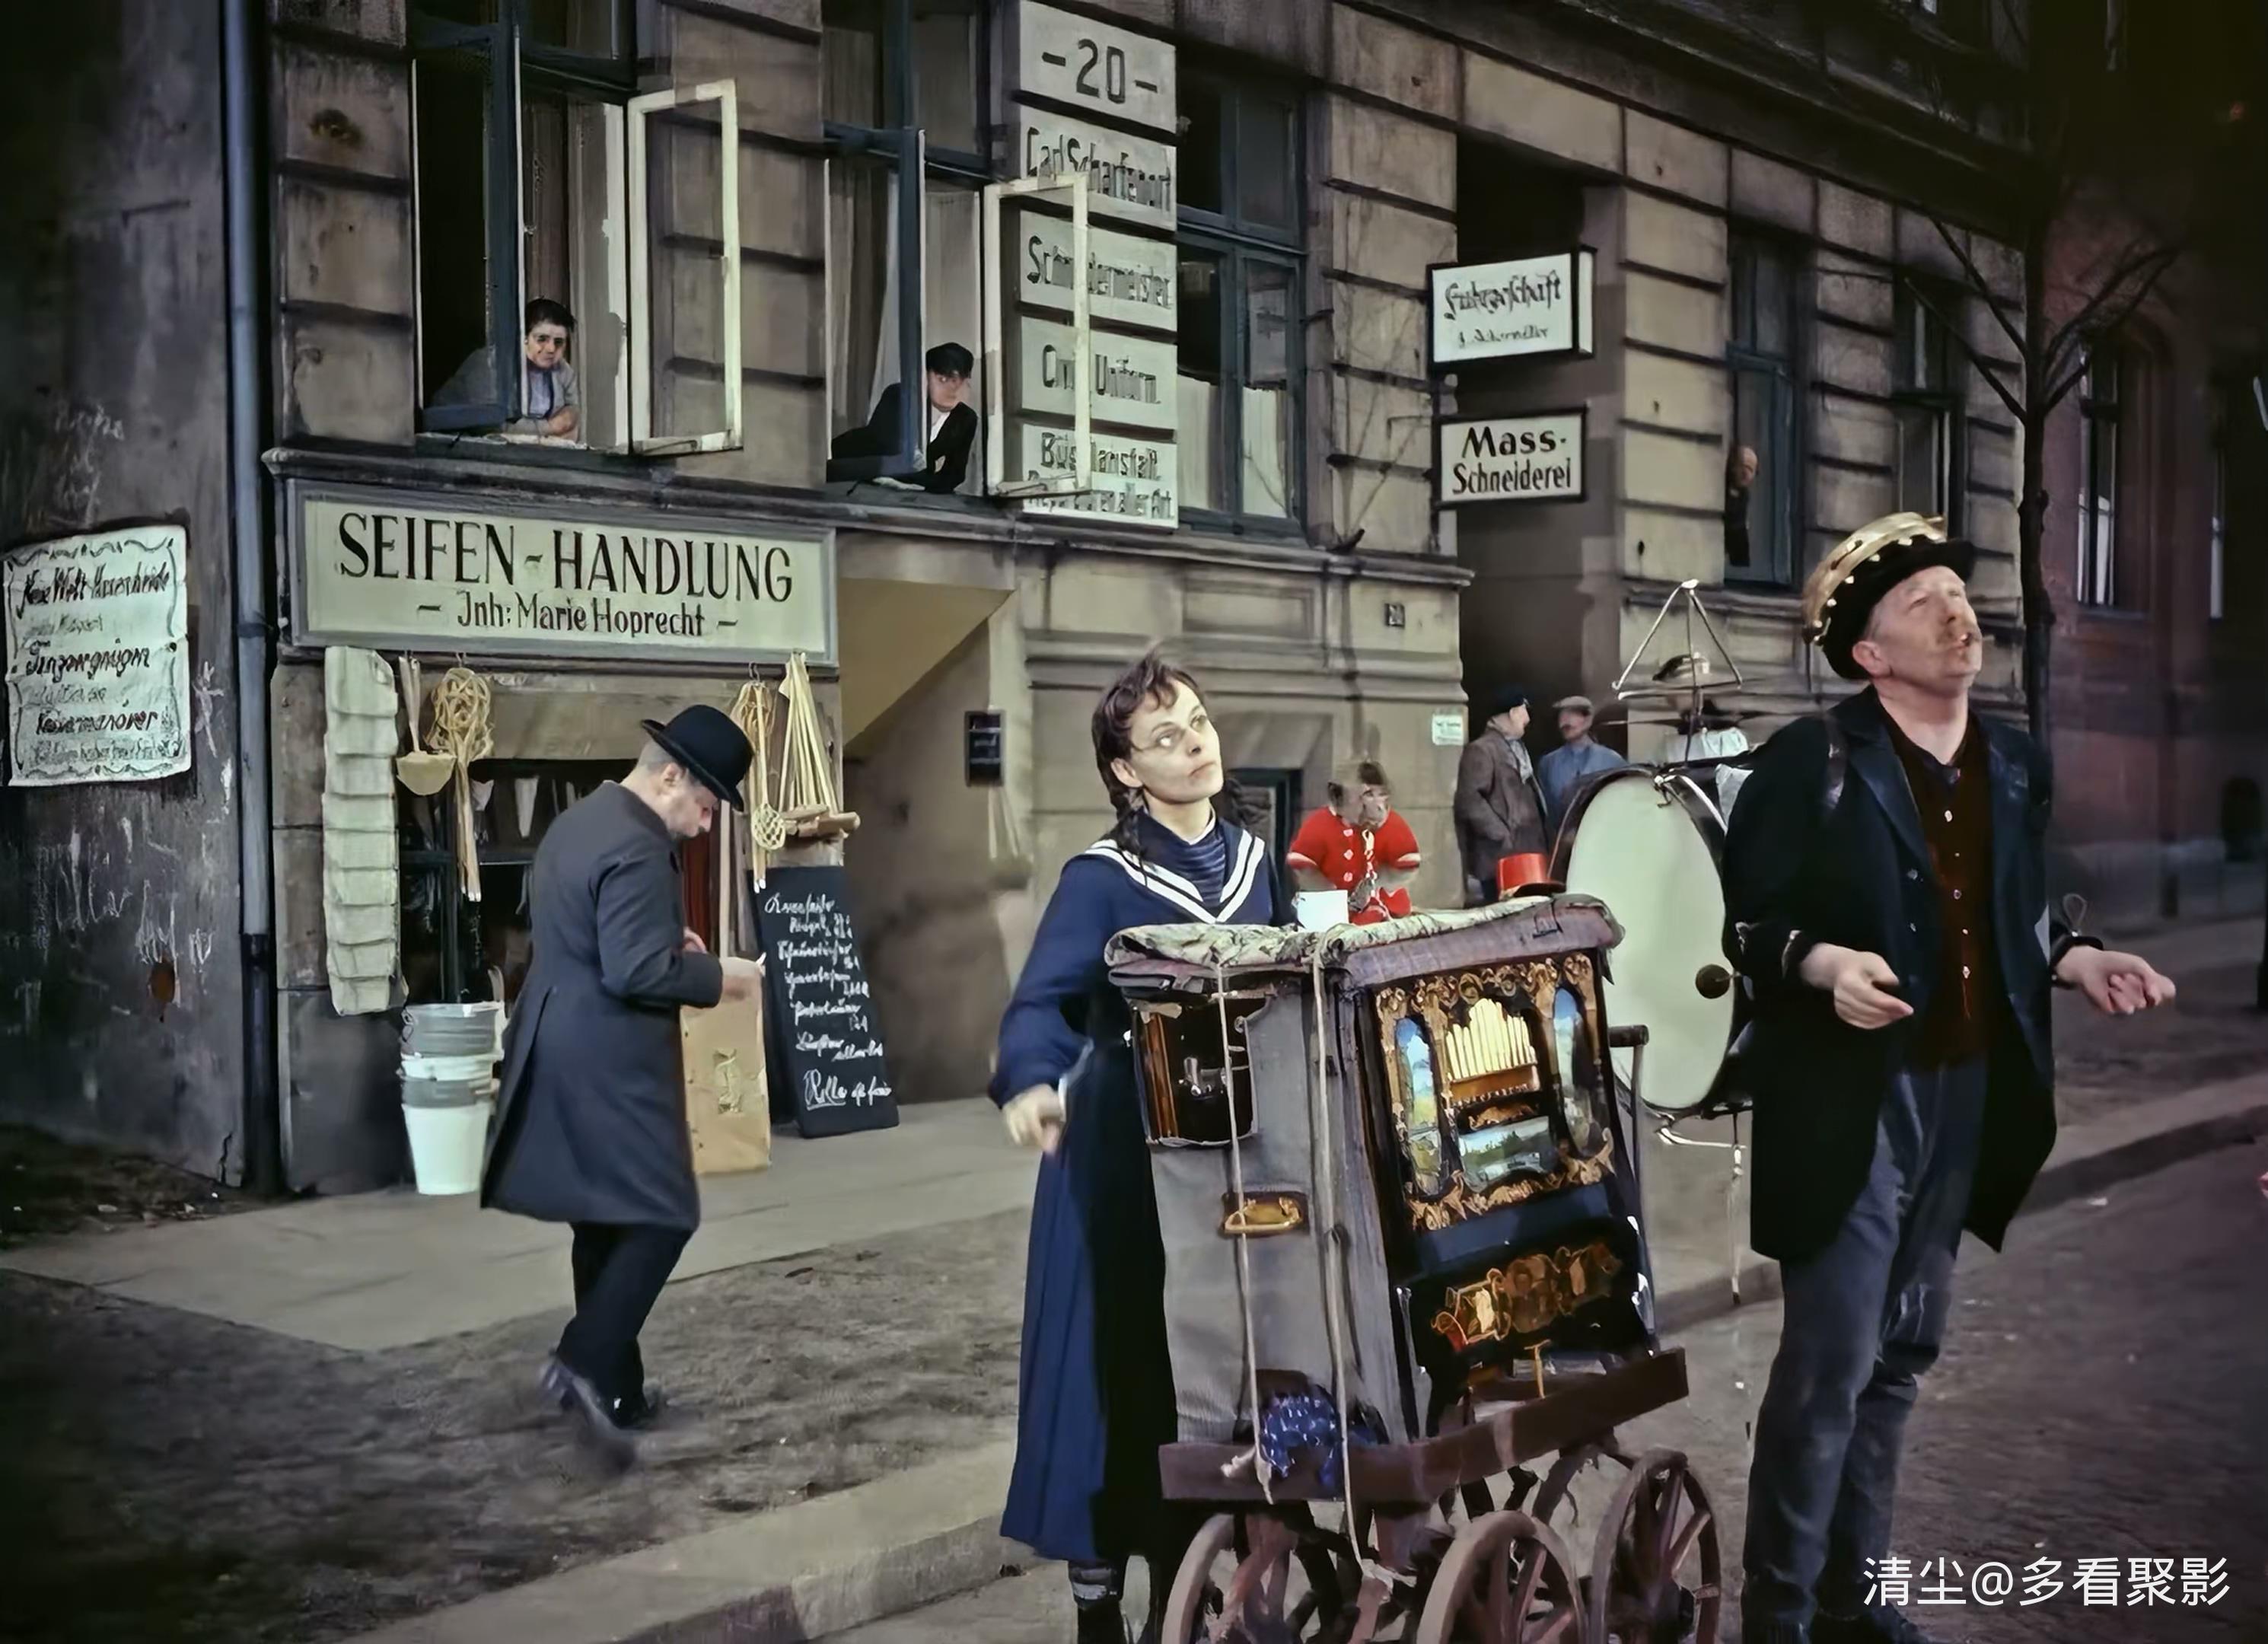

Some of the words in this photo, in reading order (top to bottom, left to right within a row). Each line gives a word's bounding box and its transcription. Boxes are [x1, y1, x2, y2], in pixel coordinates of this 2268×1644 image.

[1452, 457, 1572, 495] Schneiderei
[517, 593, 588, 632] Marie
[592, 597, 705, 638] Hoprecht
